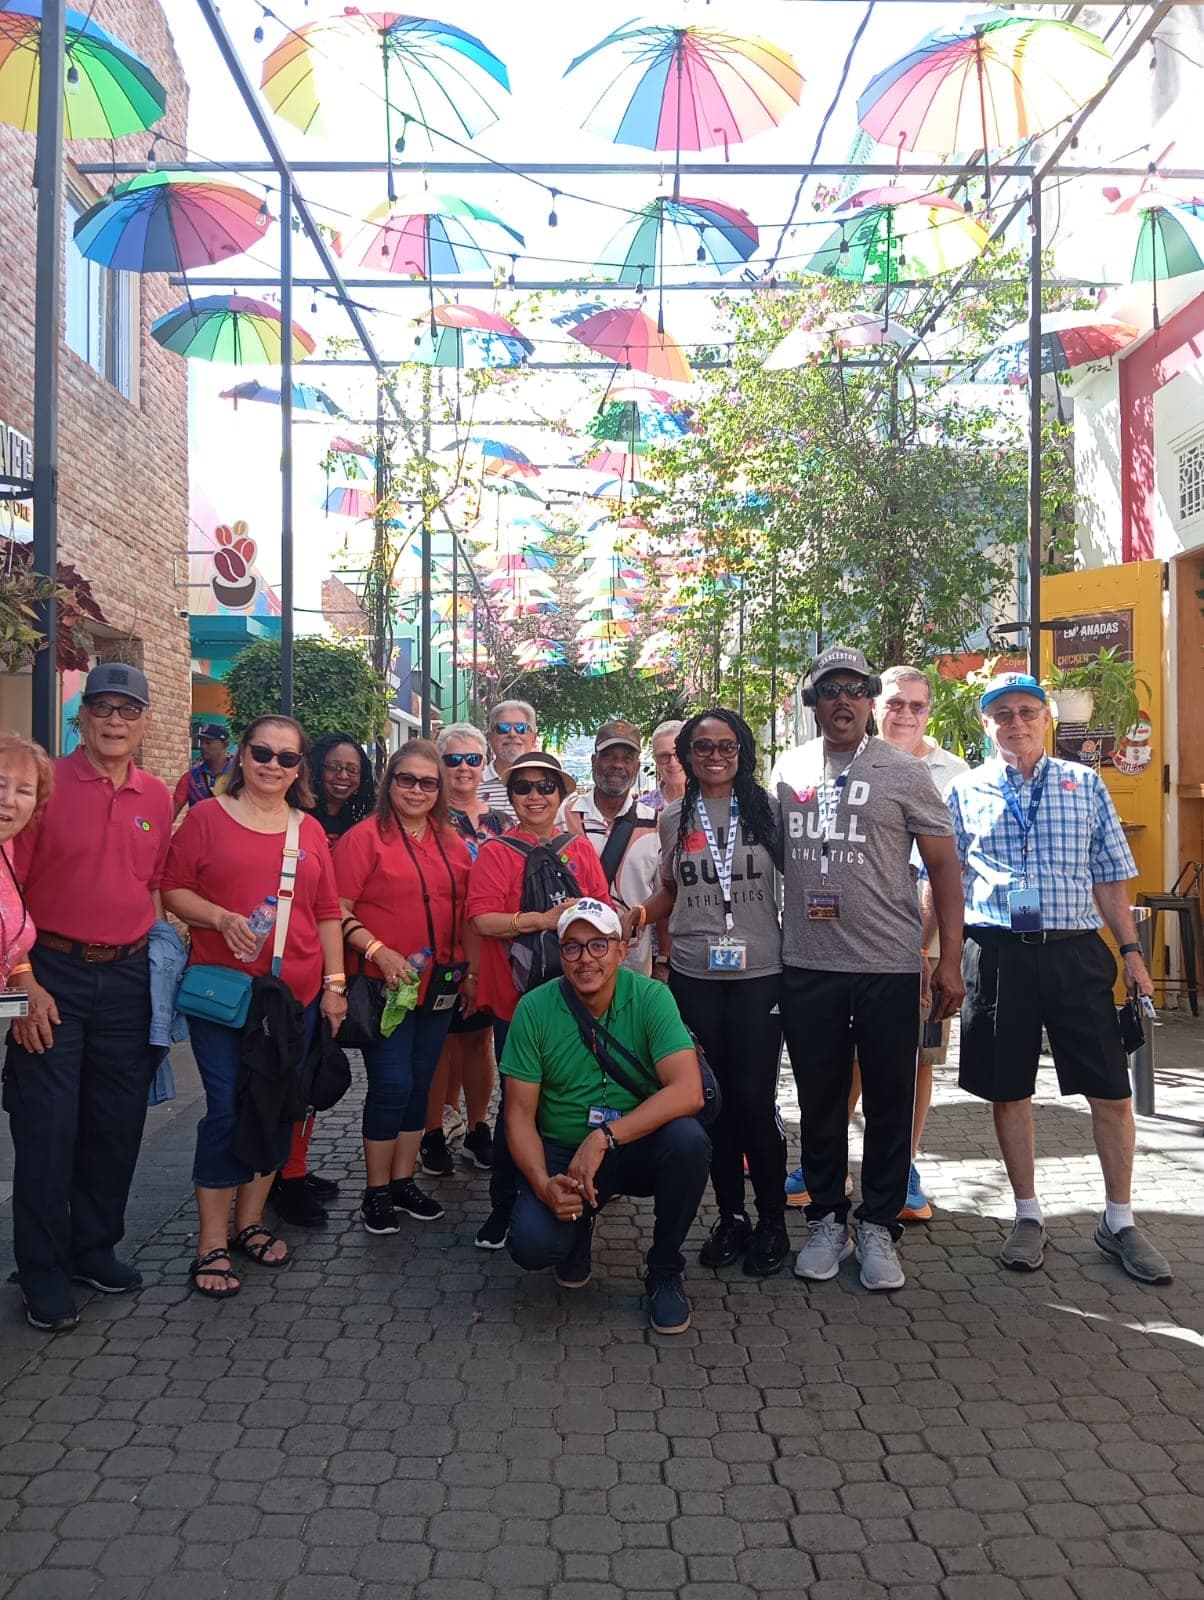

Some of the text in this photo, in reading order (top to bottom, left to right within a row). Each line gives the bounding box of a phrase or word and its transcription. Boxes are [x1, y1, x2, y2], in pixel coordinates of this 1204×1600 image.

[818, 651, 857, 669] CHARLESTON
[1057, 654, 1089, 666] CHICKEN
[788, 811, 866, 843] BULL
[791, 847, 865, 865] ATHLTICS
[577, 900, 603, 912] 2M
[687, 889, 764, 909] ATHLTICS
